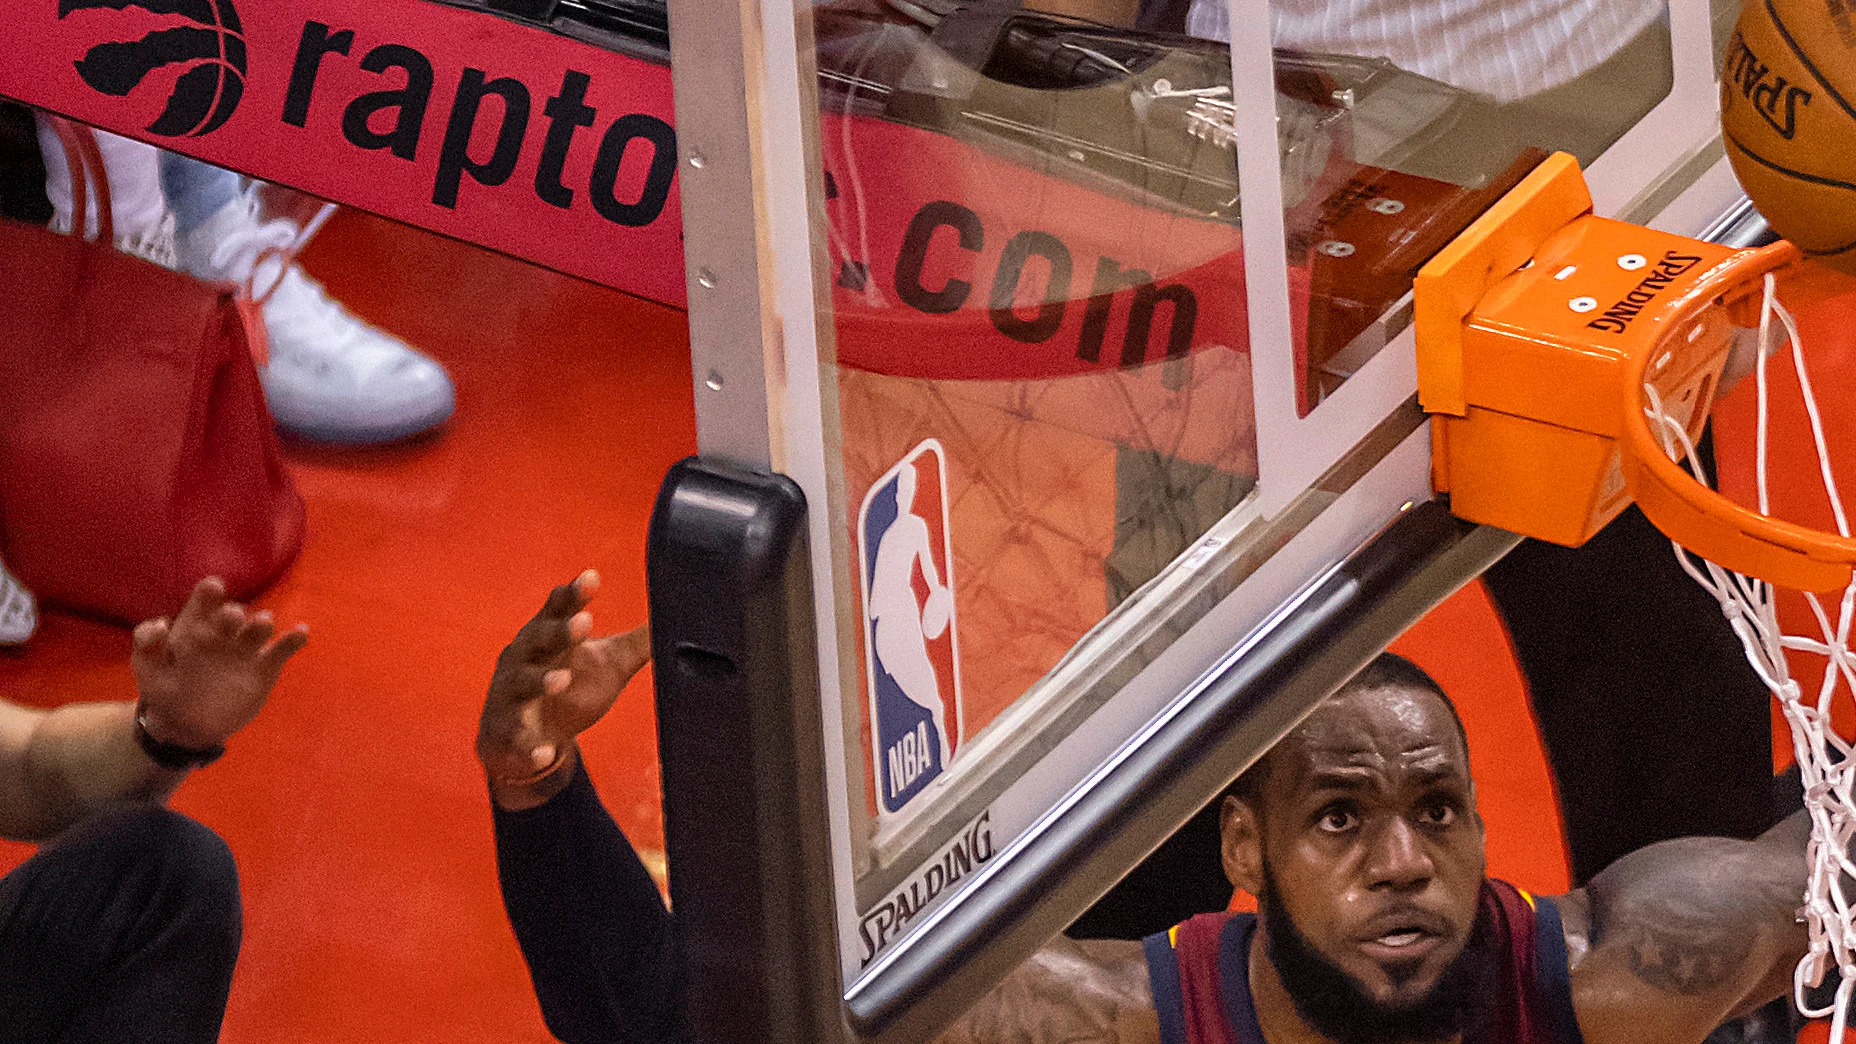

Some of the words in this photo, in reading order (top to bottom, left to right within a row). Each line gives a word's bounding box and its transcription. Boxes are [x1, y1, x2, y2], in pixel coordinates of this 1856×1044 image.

[1586, 250, 1702, 334] SPALDING
[888, 720, 931, 798] NBA
[859, 808, 995, 970] SPALDING
